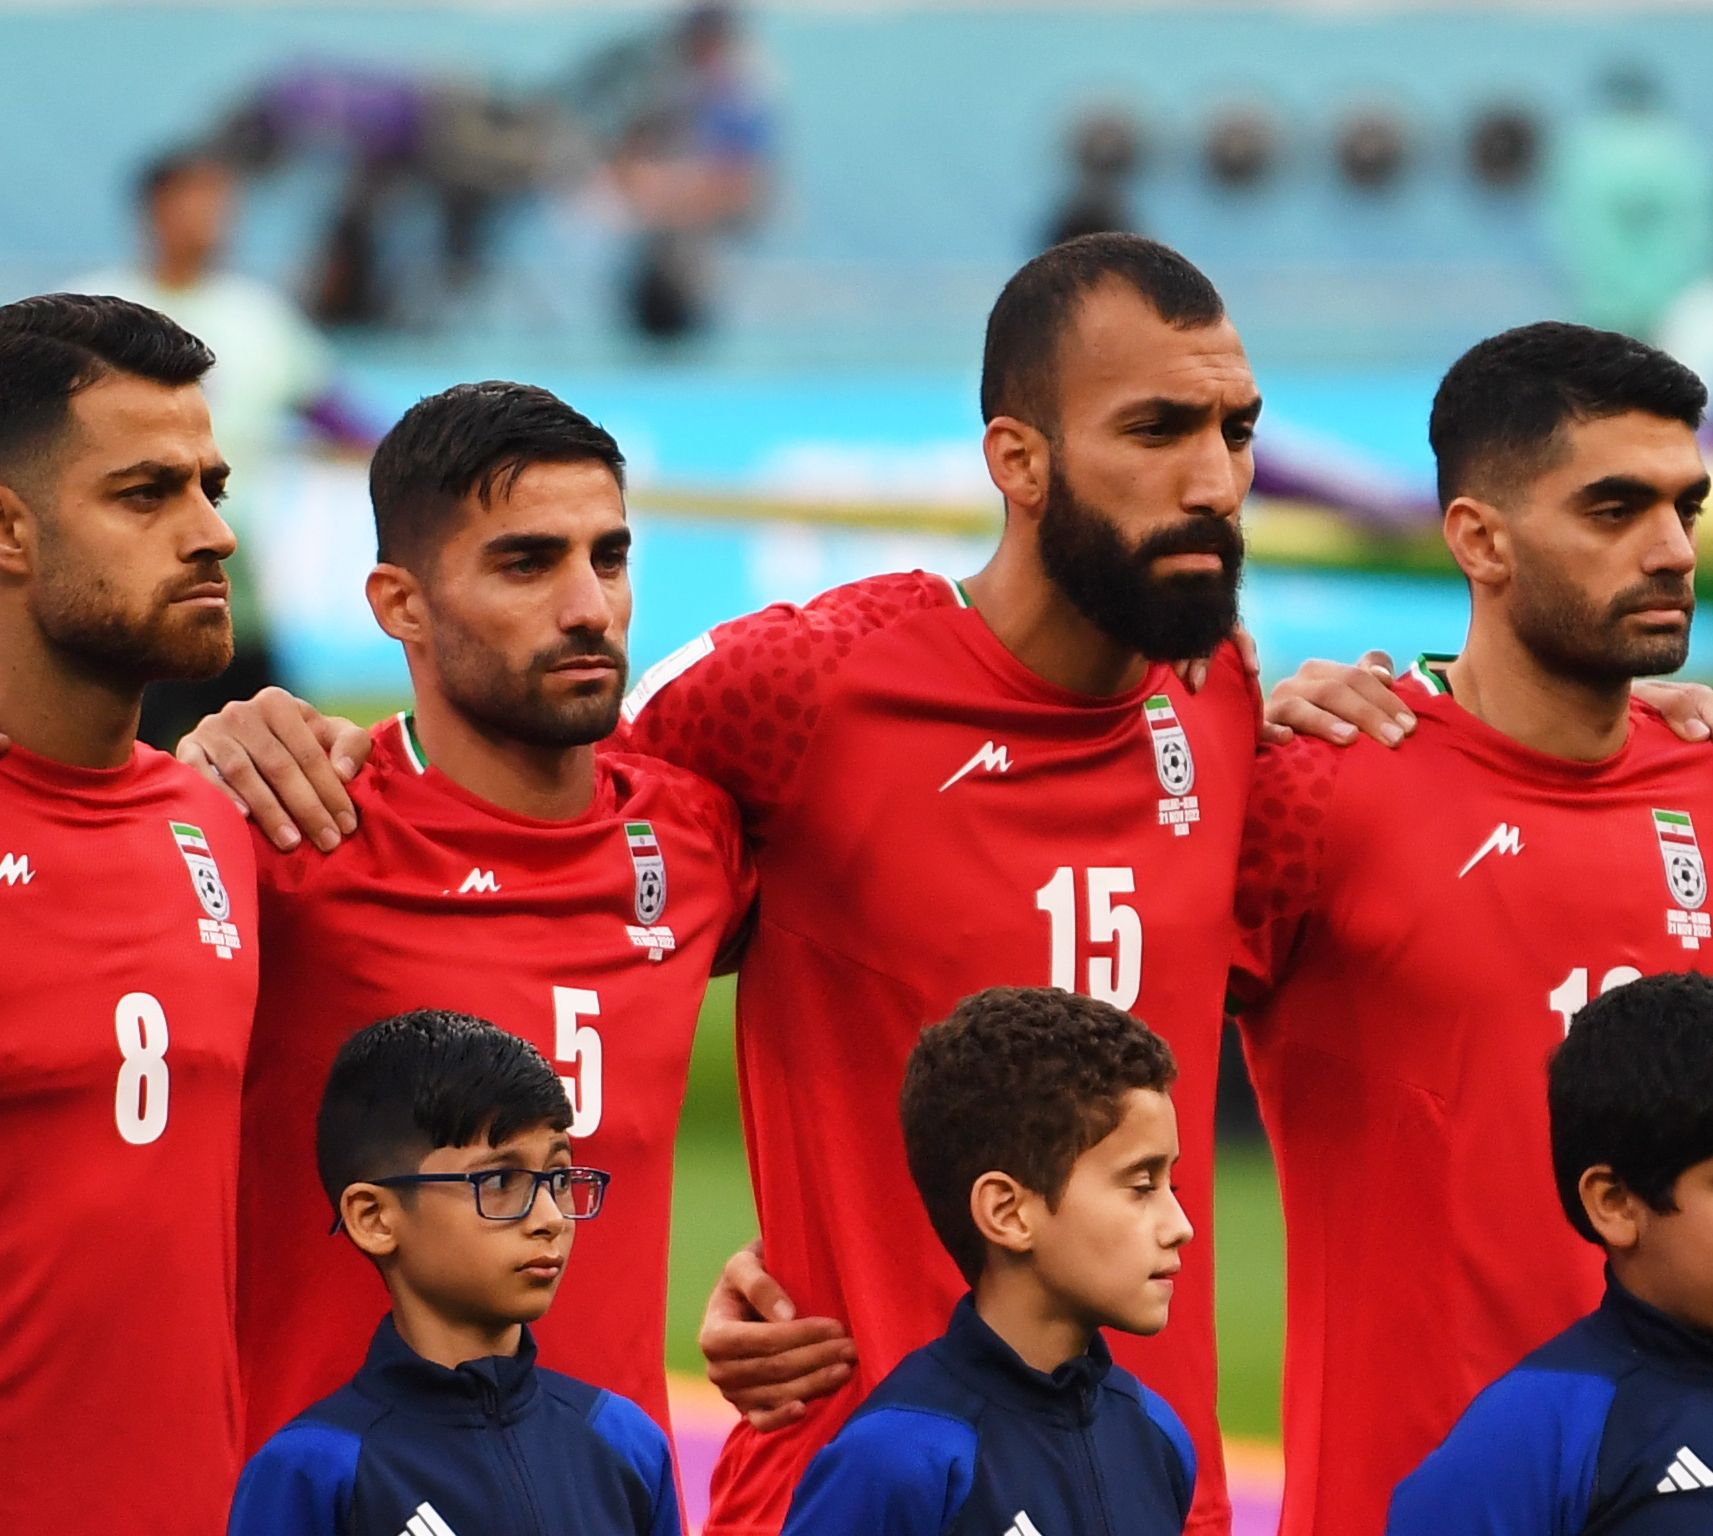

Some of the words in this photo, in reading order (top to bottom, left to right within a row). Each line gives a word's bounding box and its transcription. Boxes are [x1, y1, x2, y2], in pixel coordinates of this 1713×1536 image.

[1035, 866, 1143, 1013] 15
[114, 991, 170, 1145] 8
[552, 985, 603, 1138] 5
